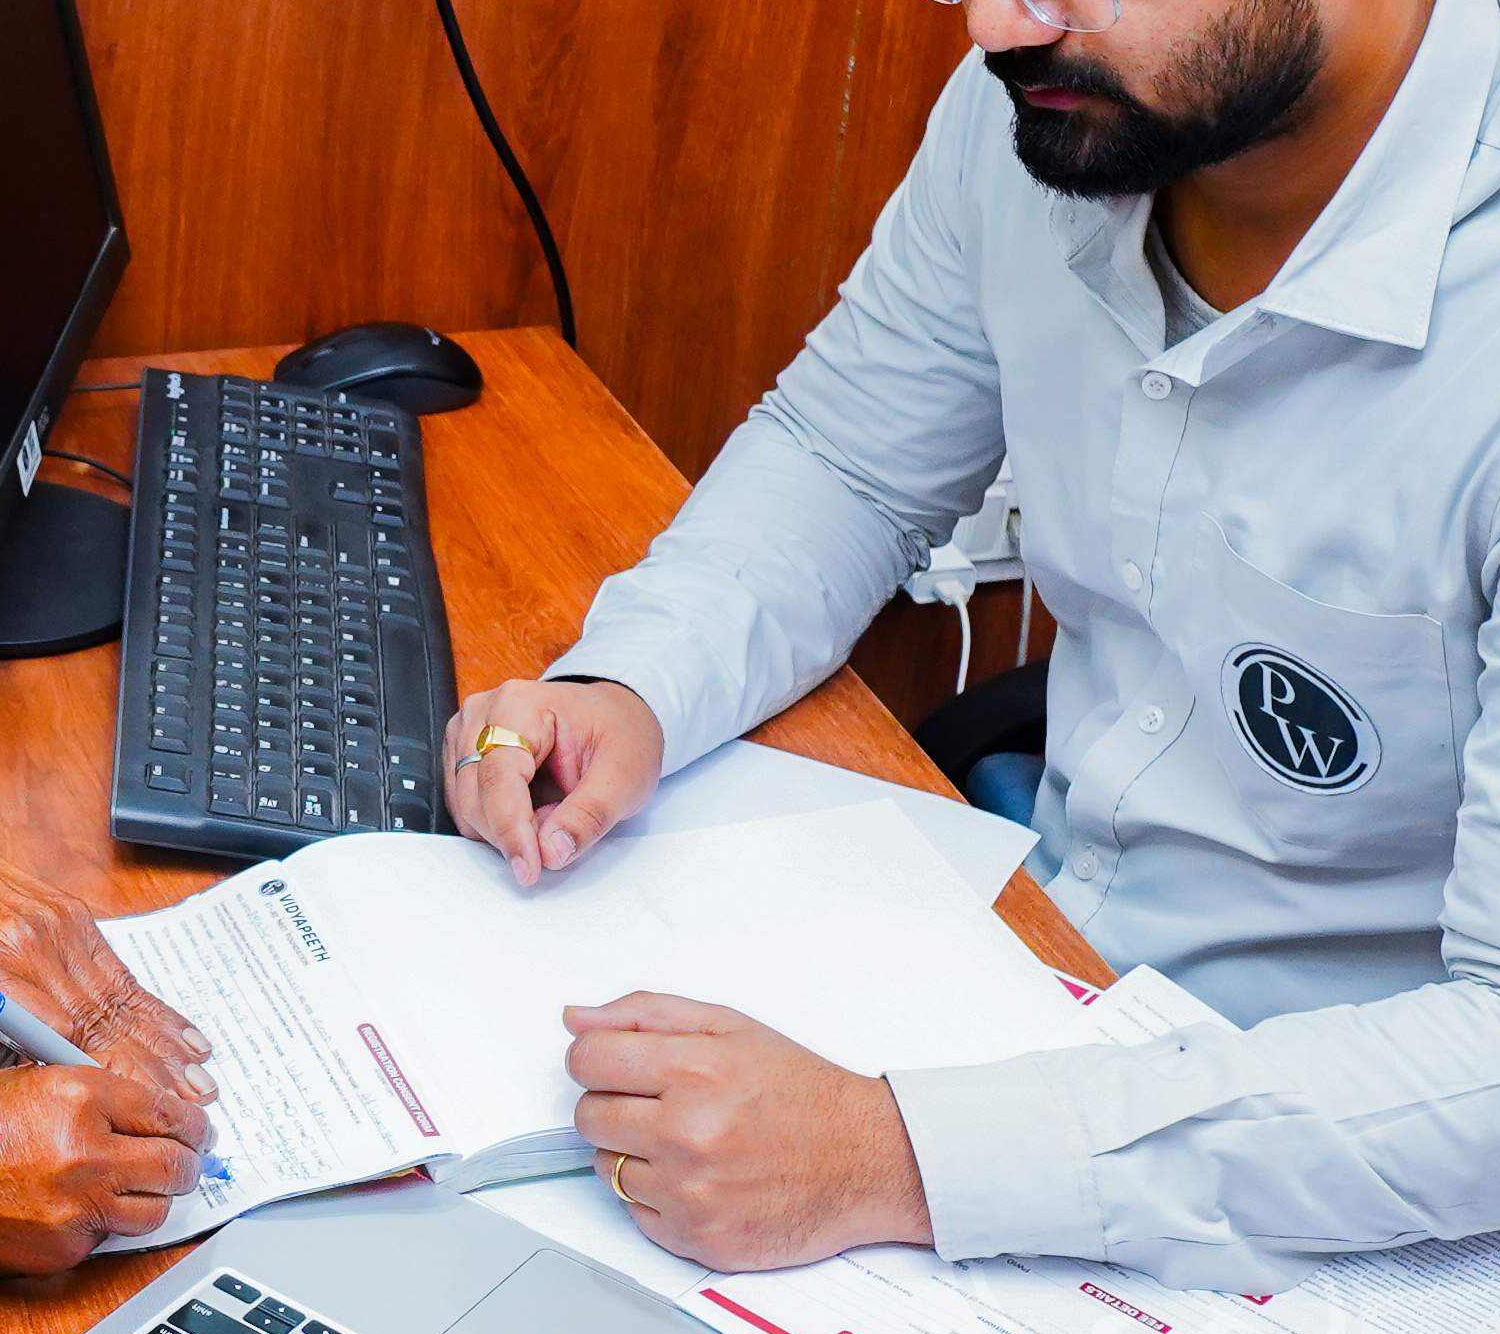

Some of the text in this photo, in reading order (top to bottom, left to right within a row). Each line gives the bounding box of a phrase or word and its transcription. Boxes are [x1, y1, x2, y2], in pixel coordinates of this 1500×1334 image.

[1256, 660, 1345, 780] PW
[279, 894, 331, 963] VIDYAPEETH
[190, 1303, 213, 1318] shift
[1083, 1283, 1165, 1330] FEE DETAILS
